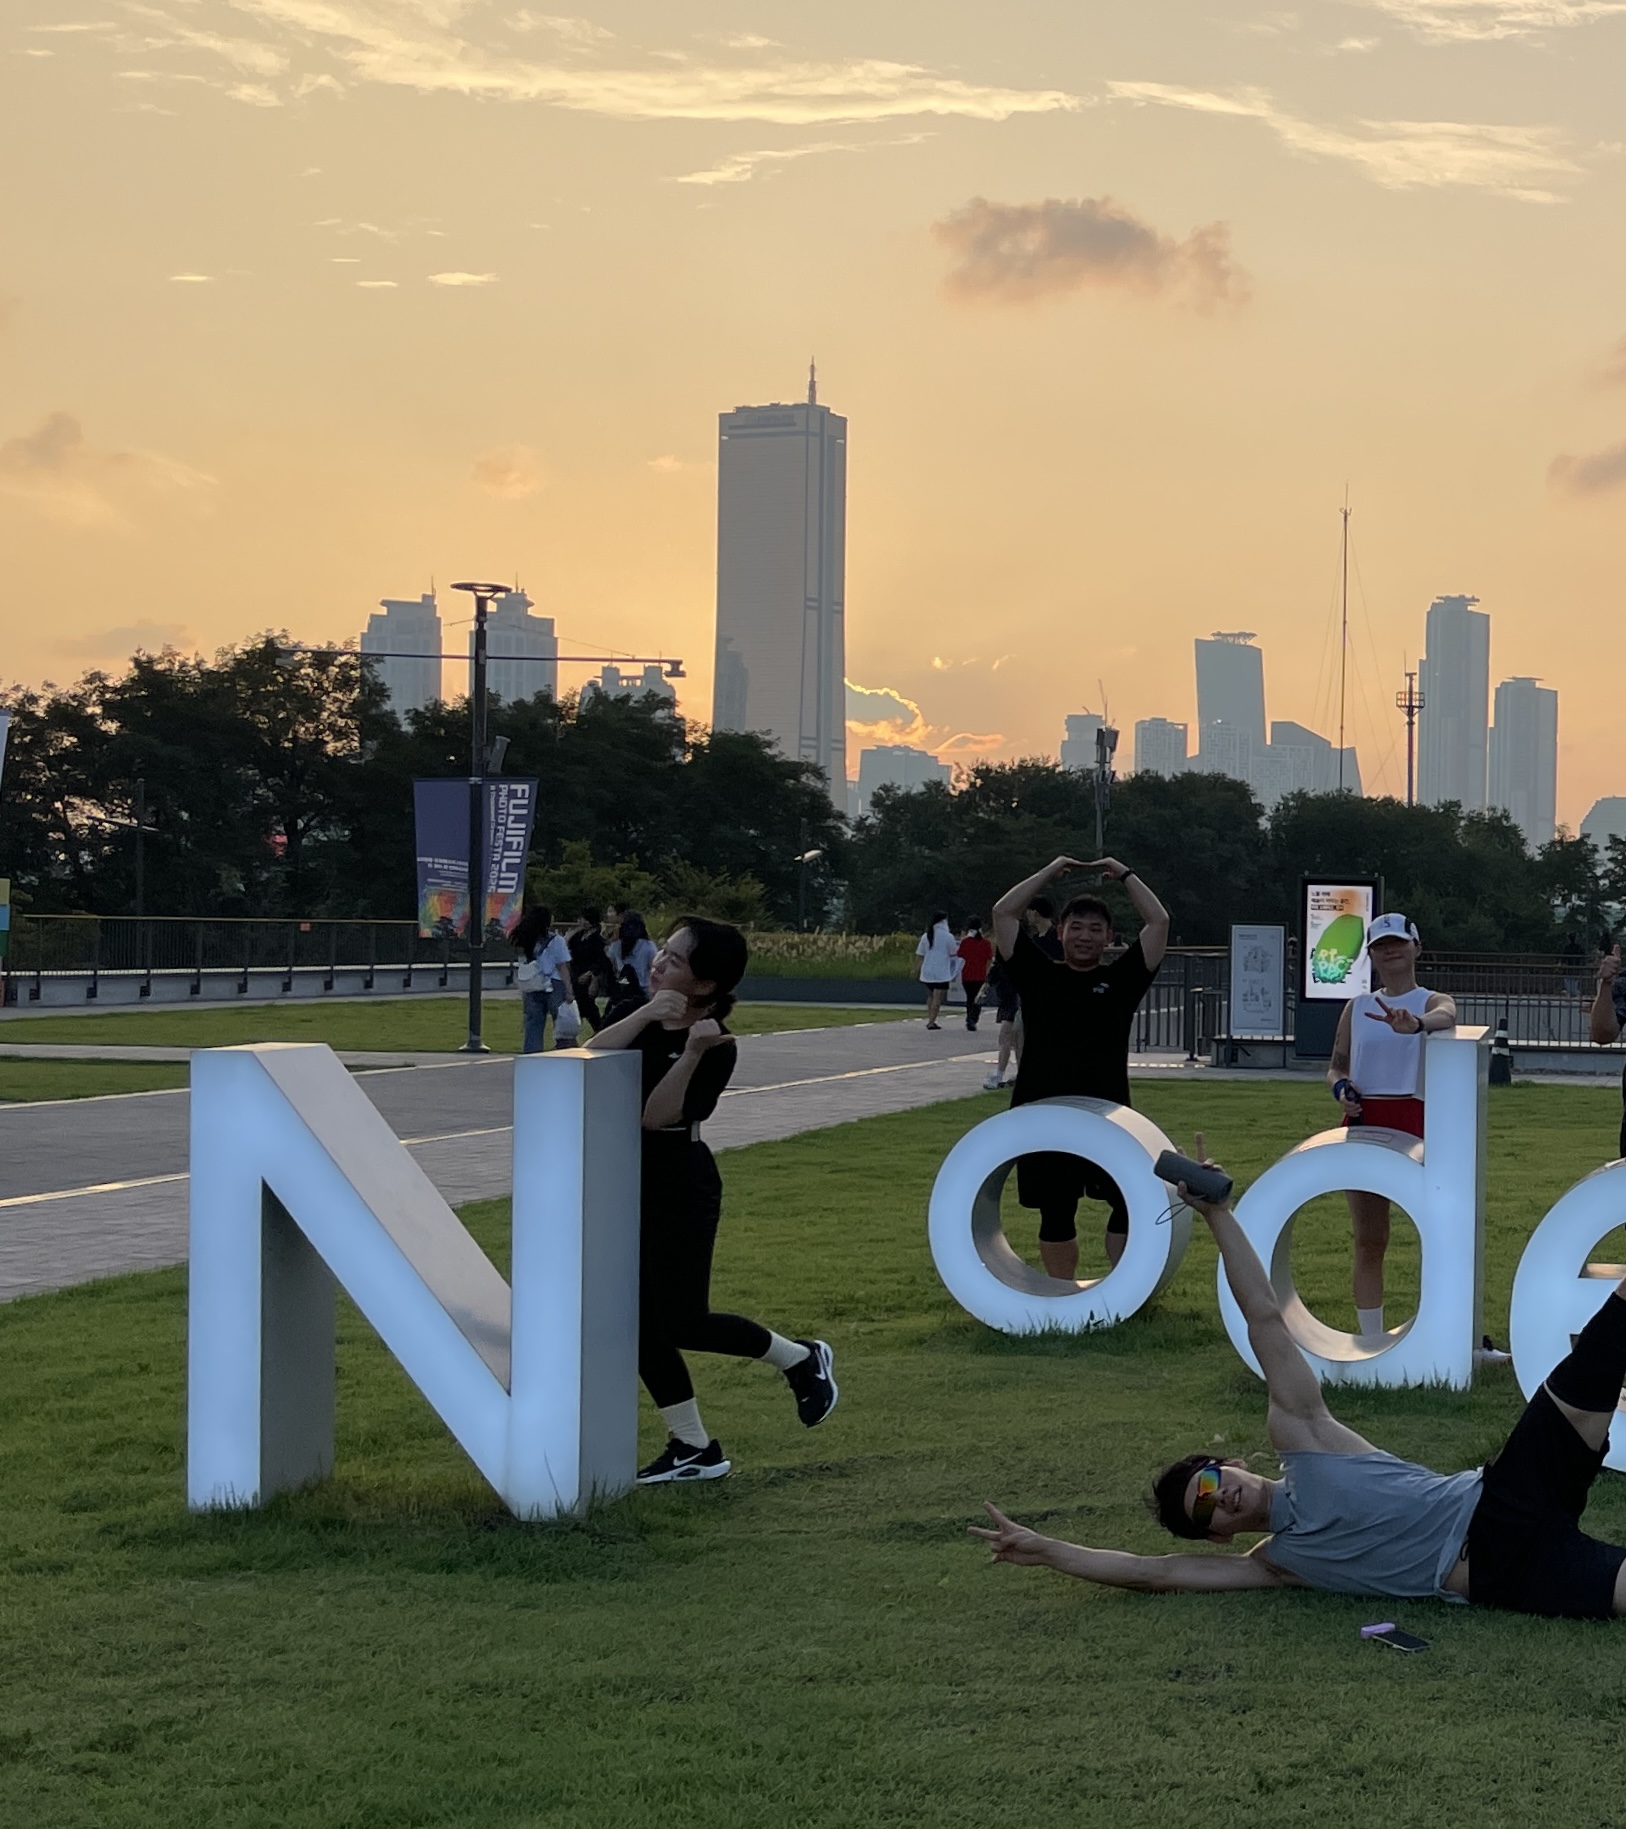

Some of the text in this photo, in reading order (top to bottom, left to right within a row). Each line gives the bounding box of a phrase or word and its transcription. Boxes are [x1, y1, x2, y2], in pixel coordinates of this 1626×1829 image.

[497, 784, 508, 823] PHOTO
[492, 825, 506, 861] FESTA
[497, 783, 530, 894] FUJIFILM
